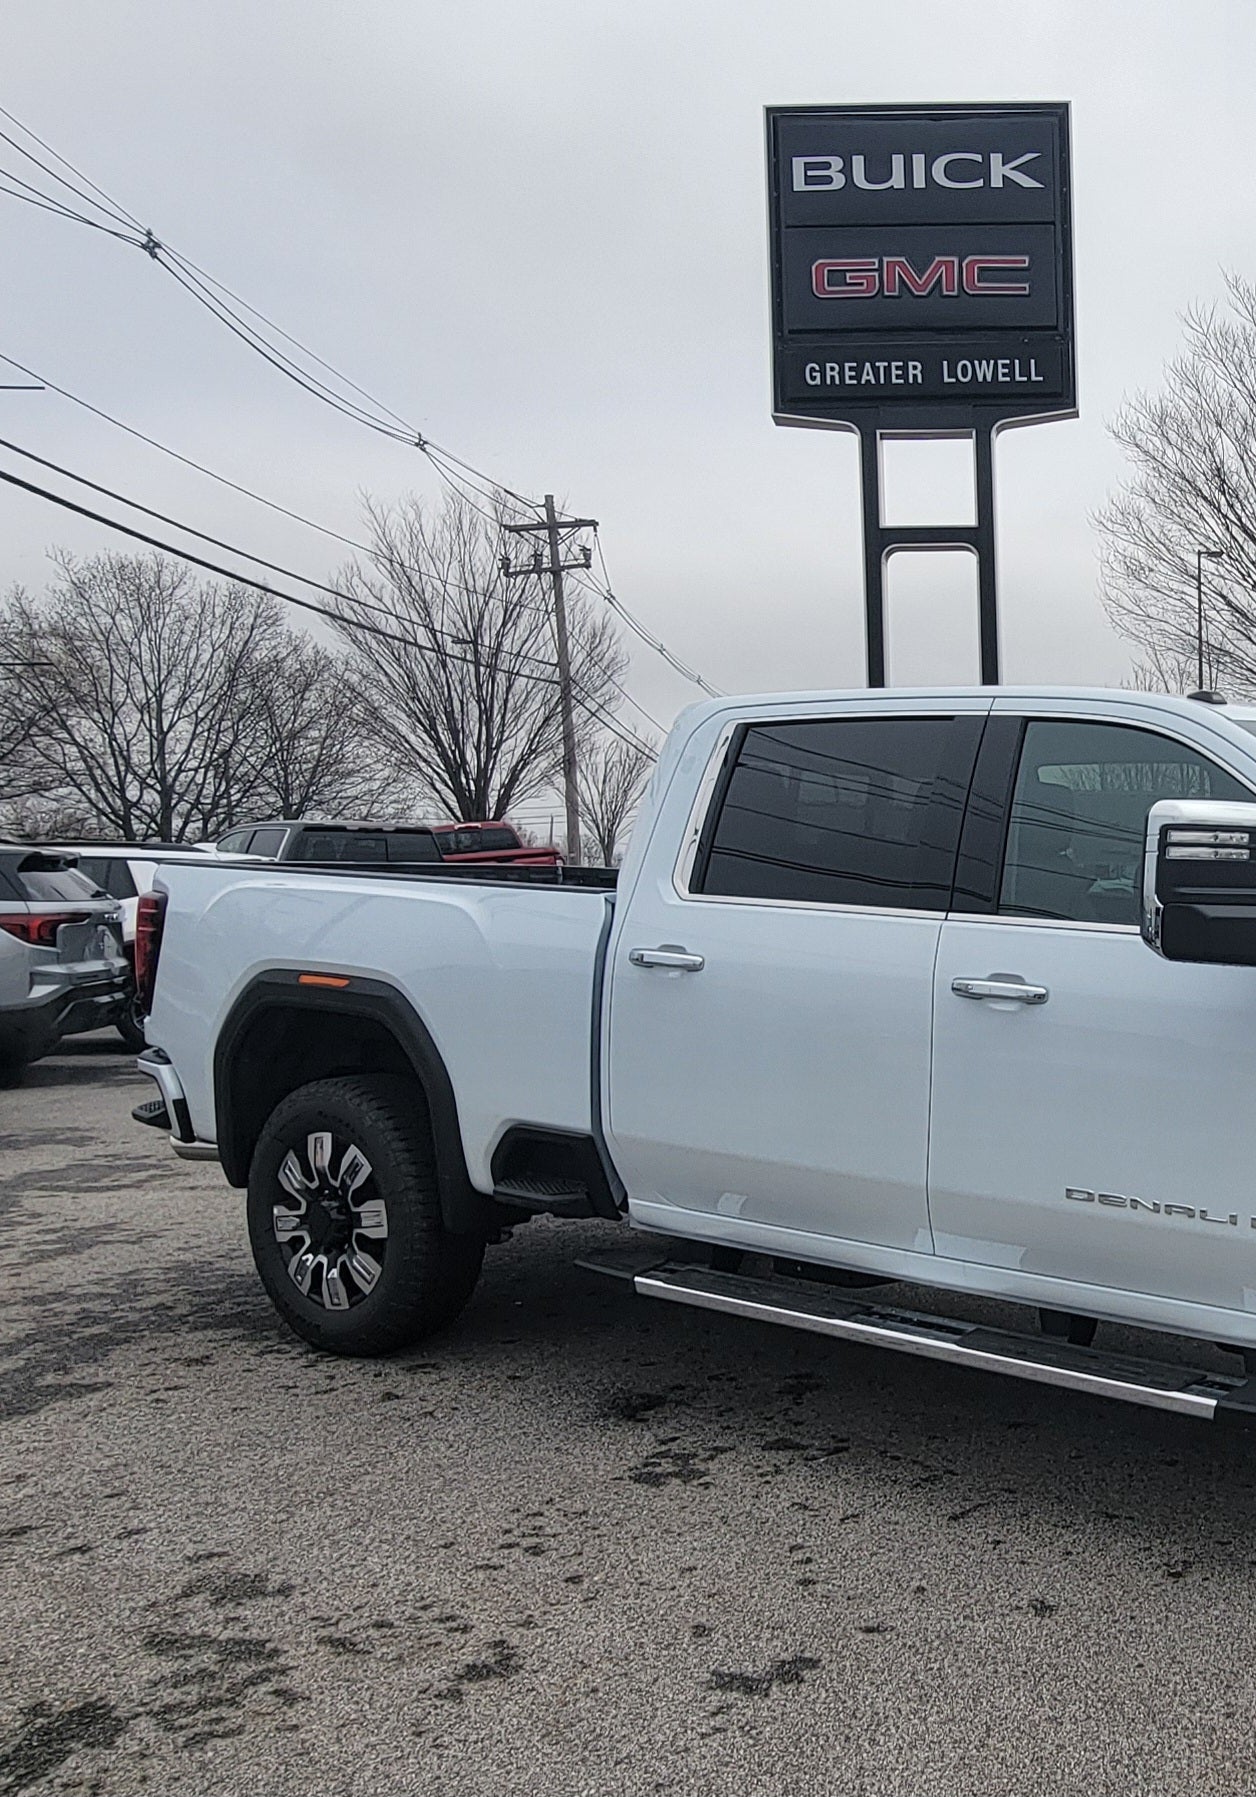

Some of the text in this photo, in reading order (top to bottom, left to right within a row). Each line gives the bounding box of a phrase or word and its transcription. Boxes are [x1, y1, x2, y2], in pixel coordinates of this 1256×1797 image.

[792, 152, 1044, 191] BUICK
[811, 255, 1030, 298] GMC
[805, 359, 1044, 385] GREATER LOWELL
[1065, 1187, 1237, 1226] DENALI
